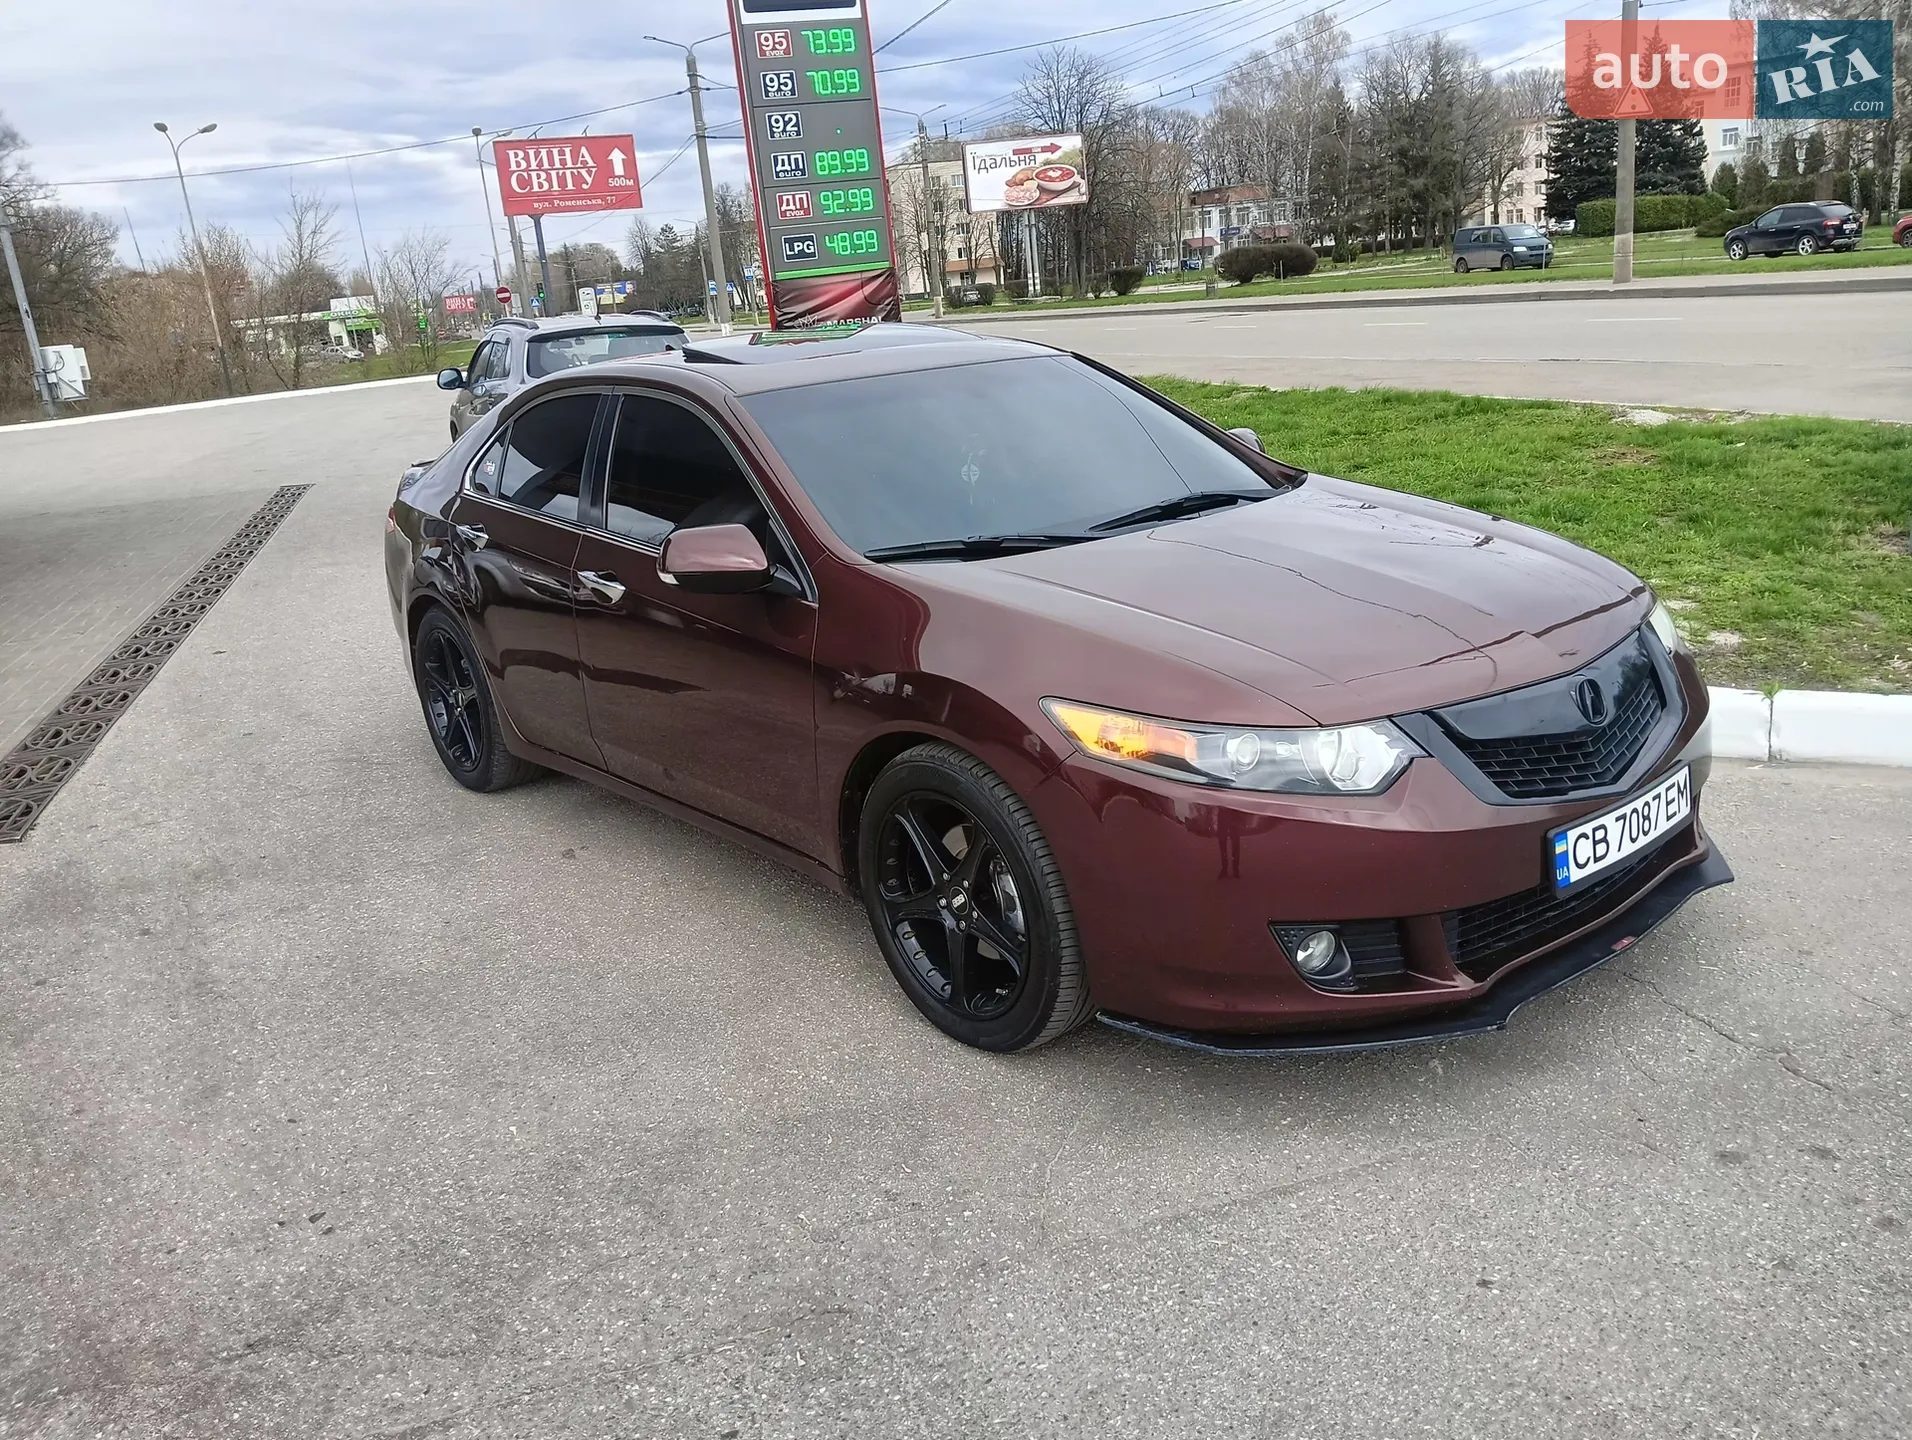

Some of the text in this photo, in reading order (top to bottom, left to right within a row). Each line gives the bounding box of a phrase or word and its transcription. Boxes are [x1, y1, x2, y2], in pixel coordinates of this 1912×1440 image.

[760, 28, 856, 54] 95 73.99
[765, 69, 861, 95] 95 70.99
[768, 90, 792, 98] euro
[771, 114, 798, 133] 92
[506, 145, 597, 171] ВИНА
[776, 148, 869, 175] ДП 89.99
[970, 152, 1037, 174] Їдальня
[510, 167, 598, 193] СВІТУ
[779, 169, 802, 177] euro
[781, 187, 874, 214] ДП 92.99
[786, 209, 805, 217] EVOX
[785, 229, 878, 255] LPG 48.99
[1572, 773, 1689, 870] CB 7087 EM
[1556, 866, 1569, 881] UA
